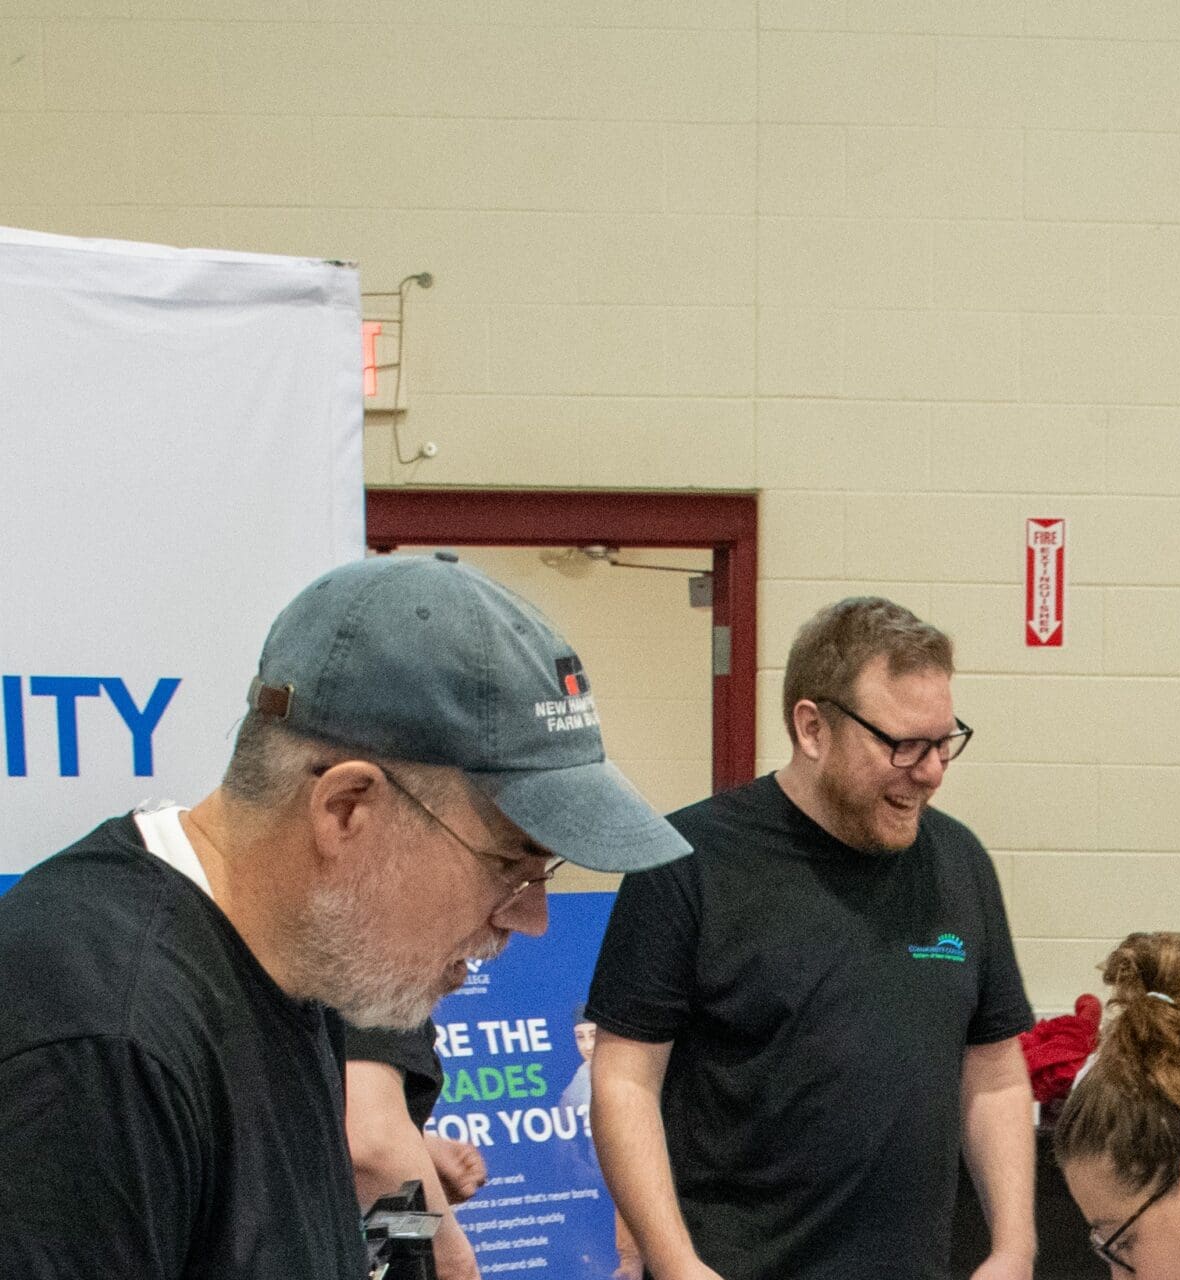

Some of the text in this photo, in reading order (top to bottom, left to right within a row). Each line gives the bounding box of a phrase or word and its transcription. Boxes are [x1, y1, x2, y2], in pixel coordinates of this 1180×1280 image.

[1034, 531, 1056, 544] FIRE
[1040, 547, 1049, 633] EXTINGUISHER
[535, 700, 567, 717] NEW
[547, 713, 584, 732] FARM
[2, 675, 183, 777] ITY
[477, 1018, 552, 1055] THE
